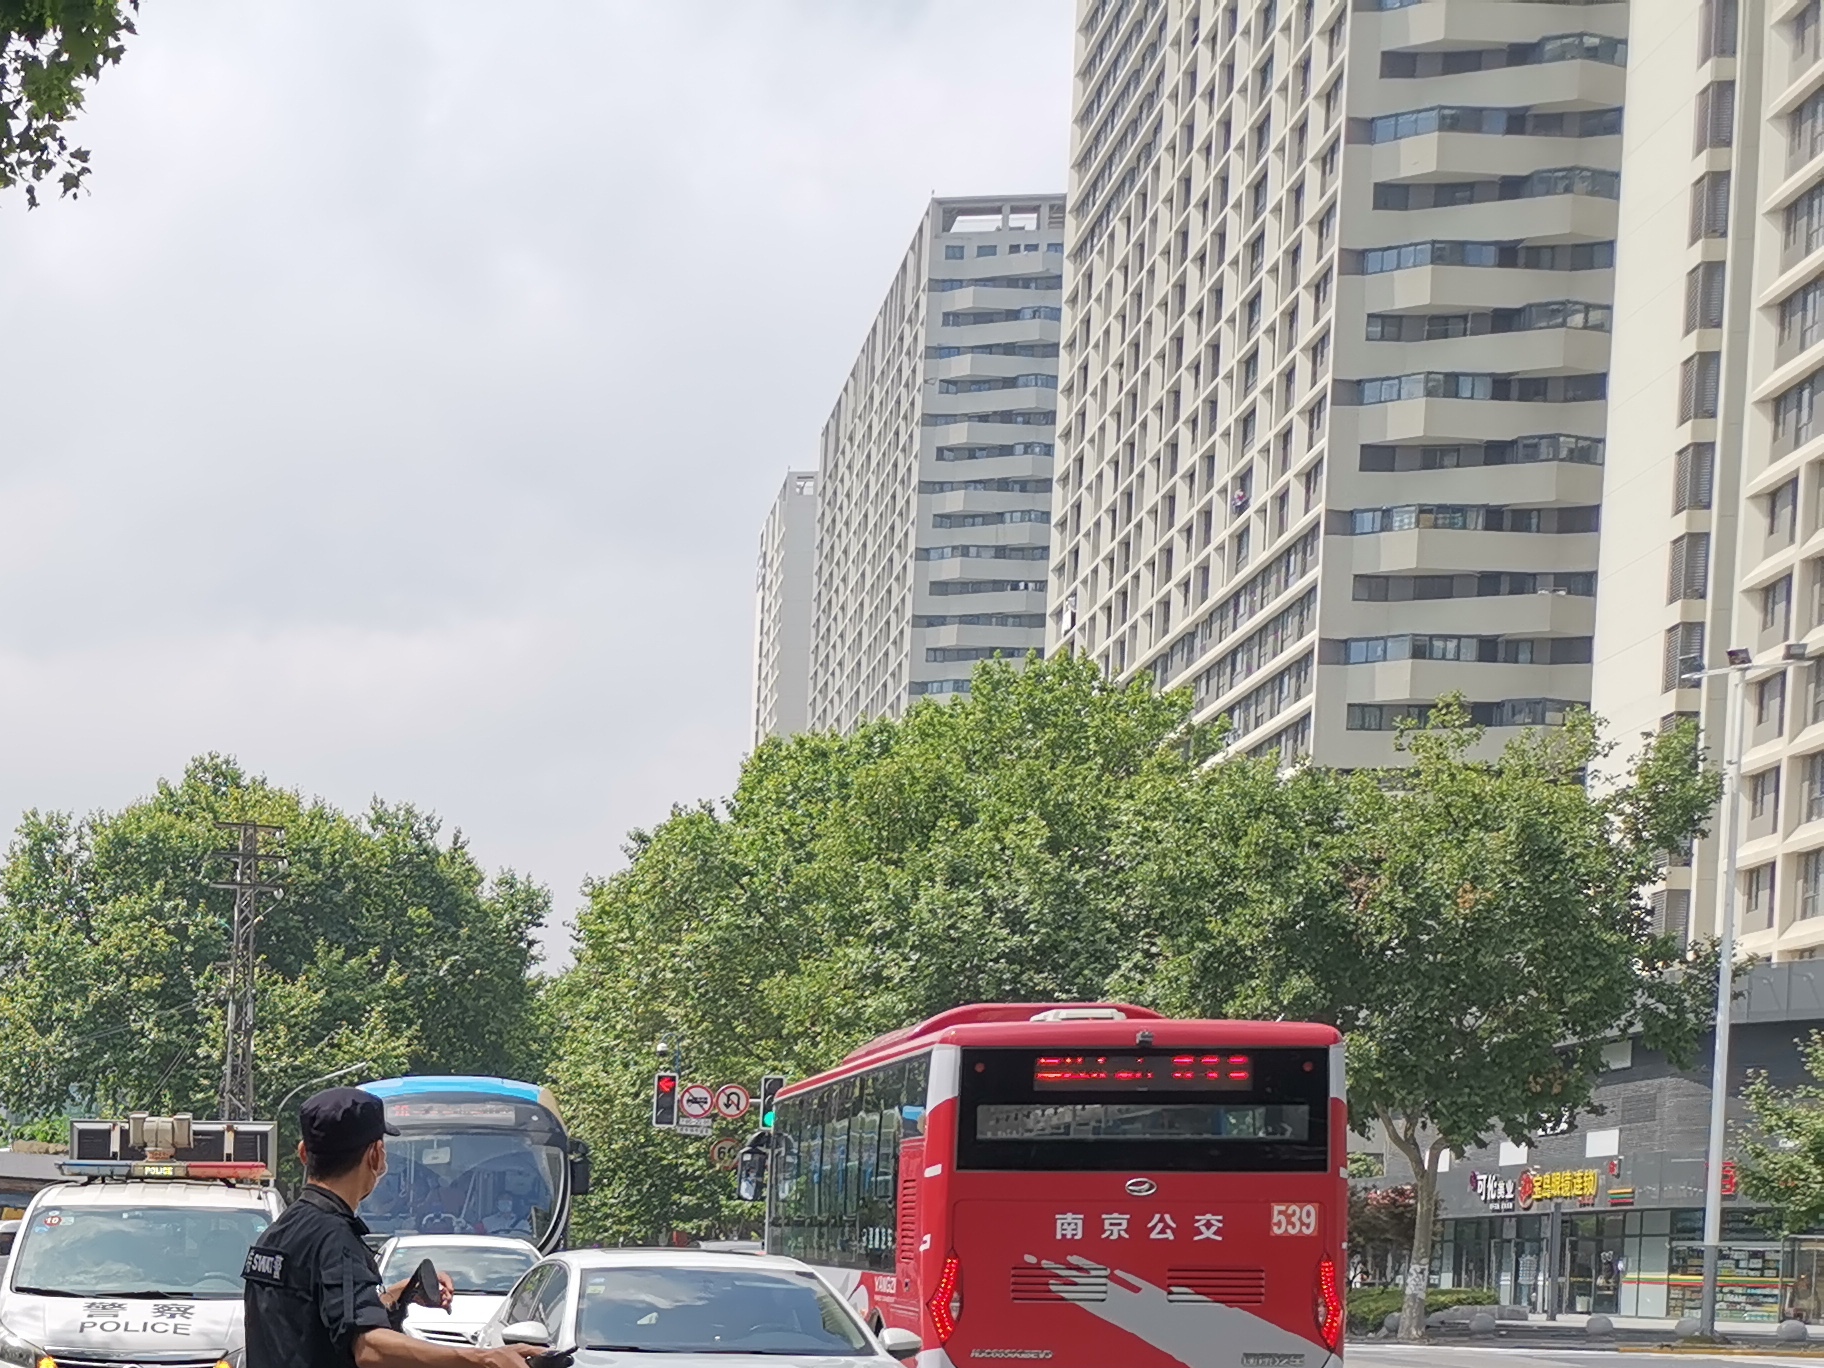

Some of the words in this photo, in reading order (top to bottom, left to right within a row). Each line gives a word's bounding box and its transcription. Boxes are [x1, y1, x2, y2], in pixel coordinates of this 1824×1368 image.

[1055, 1212, 1224, 1241] 南京公交
[1272, 1204, 1316, 1235] 539
[83, 1302, 195, 1320] 警察
[79, 1321, 192, 1336] POLICE
